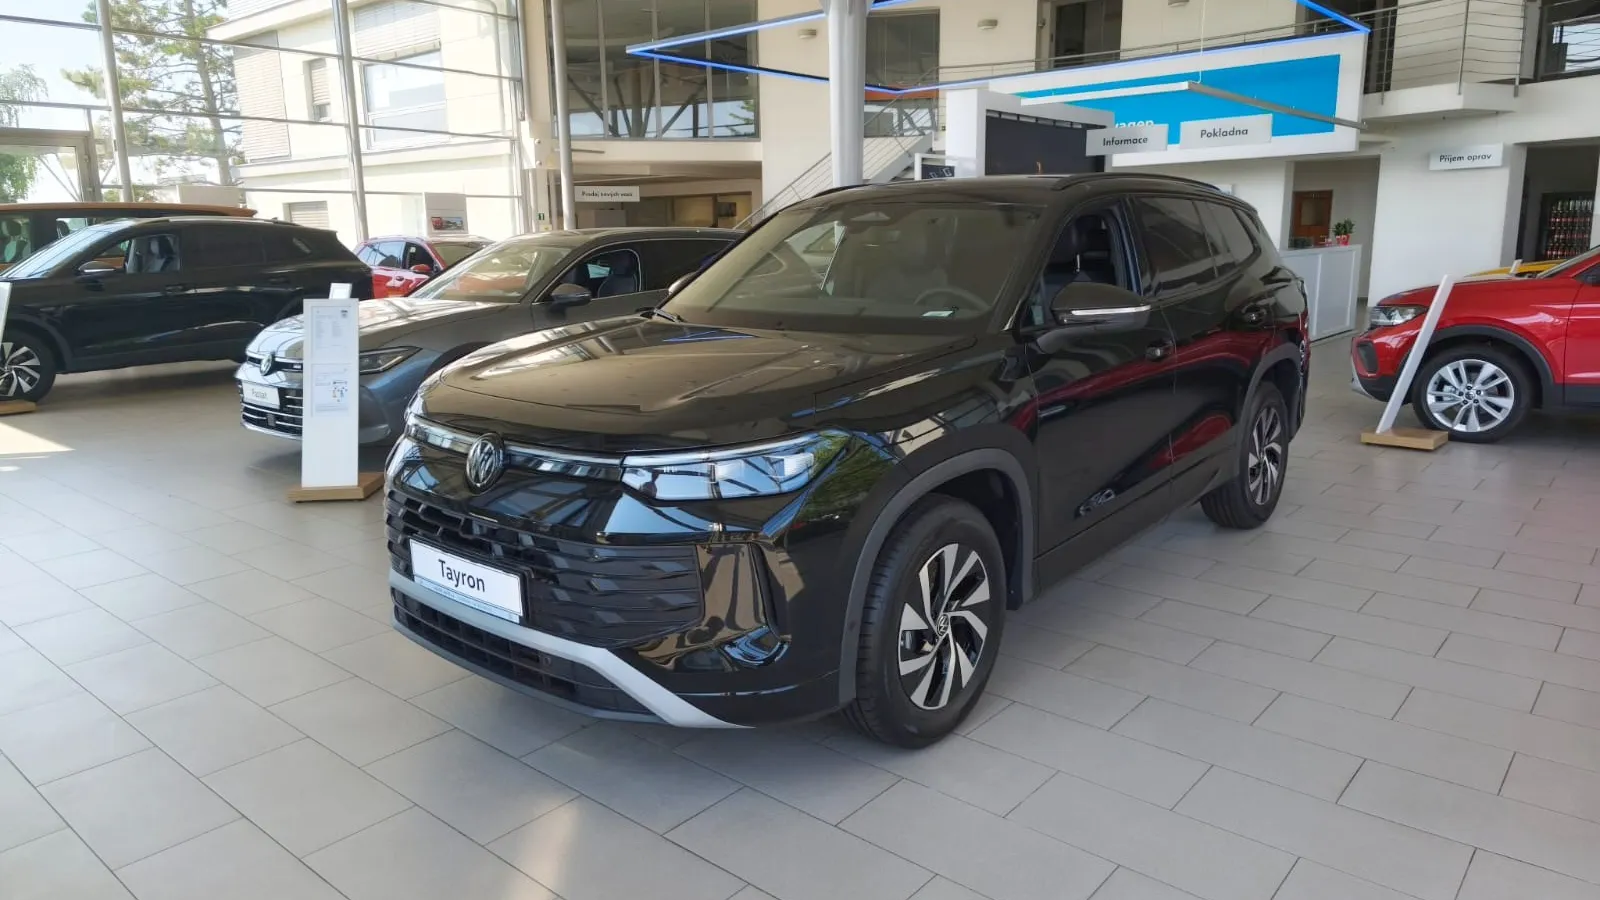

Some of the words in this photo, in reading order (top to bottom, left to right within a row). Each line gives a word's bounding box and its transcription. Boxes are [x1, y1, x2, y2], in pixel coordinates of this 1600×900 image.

[1200, 128, 1249, 139] Pokladna
[1103, 136, 1148, 146] Informace
[1467, 153, 1492, 162] oprav
[438, 558, 486, 593] Tayron
